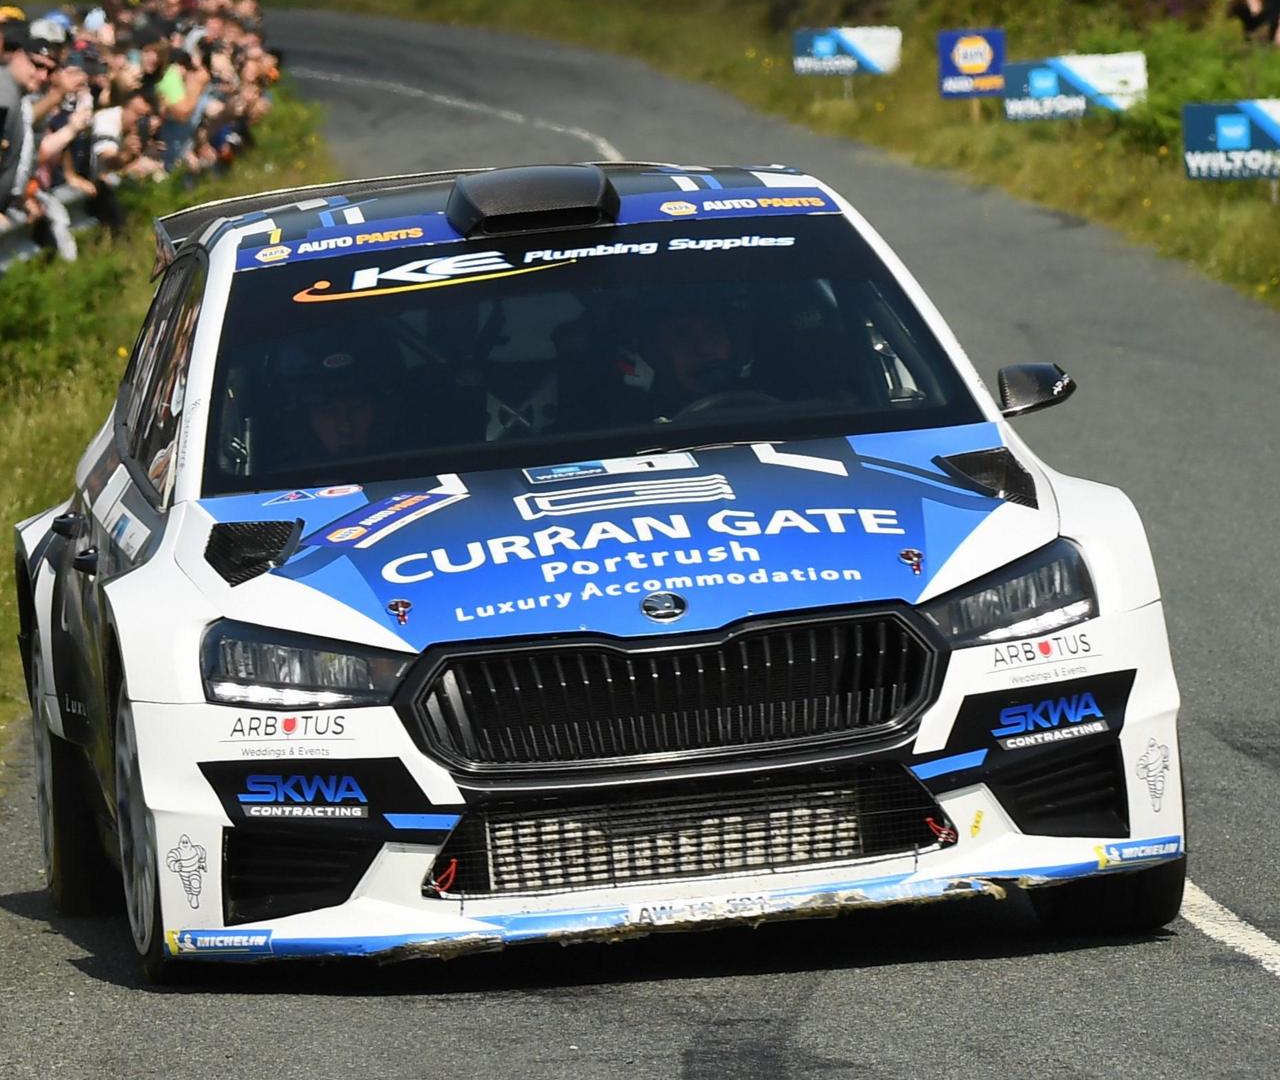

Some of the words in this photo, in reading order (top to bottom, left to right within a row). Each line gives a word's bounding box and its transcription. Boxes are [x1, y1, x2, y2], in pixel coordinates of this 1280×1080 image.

[702, 198, 757, 211] AUTO
[757, 197, 806, 208] PARTS
[297, 236, 353, 254] AUTO
[356, 226, 424, 245] PARTS
[351, 250, 515, 290] KE
[523, 240, 658, 263] Plumbing
[667, 234, 796, 252] Supplies
[381, 513, 692, 584] CURRAN
[707, 508, 906, 536] GATE
[540, 540, 761, 583] Portrush
[455, 591, 573, 622] Luxury
[582, 566, 863, 602] Accommodation
[990, 691, 1105, 737] SKWA
[1006, 723, 1104, 748] CONTRACTING
[241, 746, 286, 757] Weddings
[289, 746, 295, 755] &
[298, 746, 330, 756] Events
[237, 774, 368, 802] SKWA
[250, 806, 362, 817] CONTRACTING
[196, 935, 269, 948] MICHELIN
